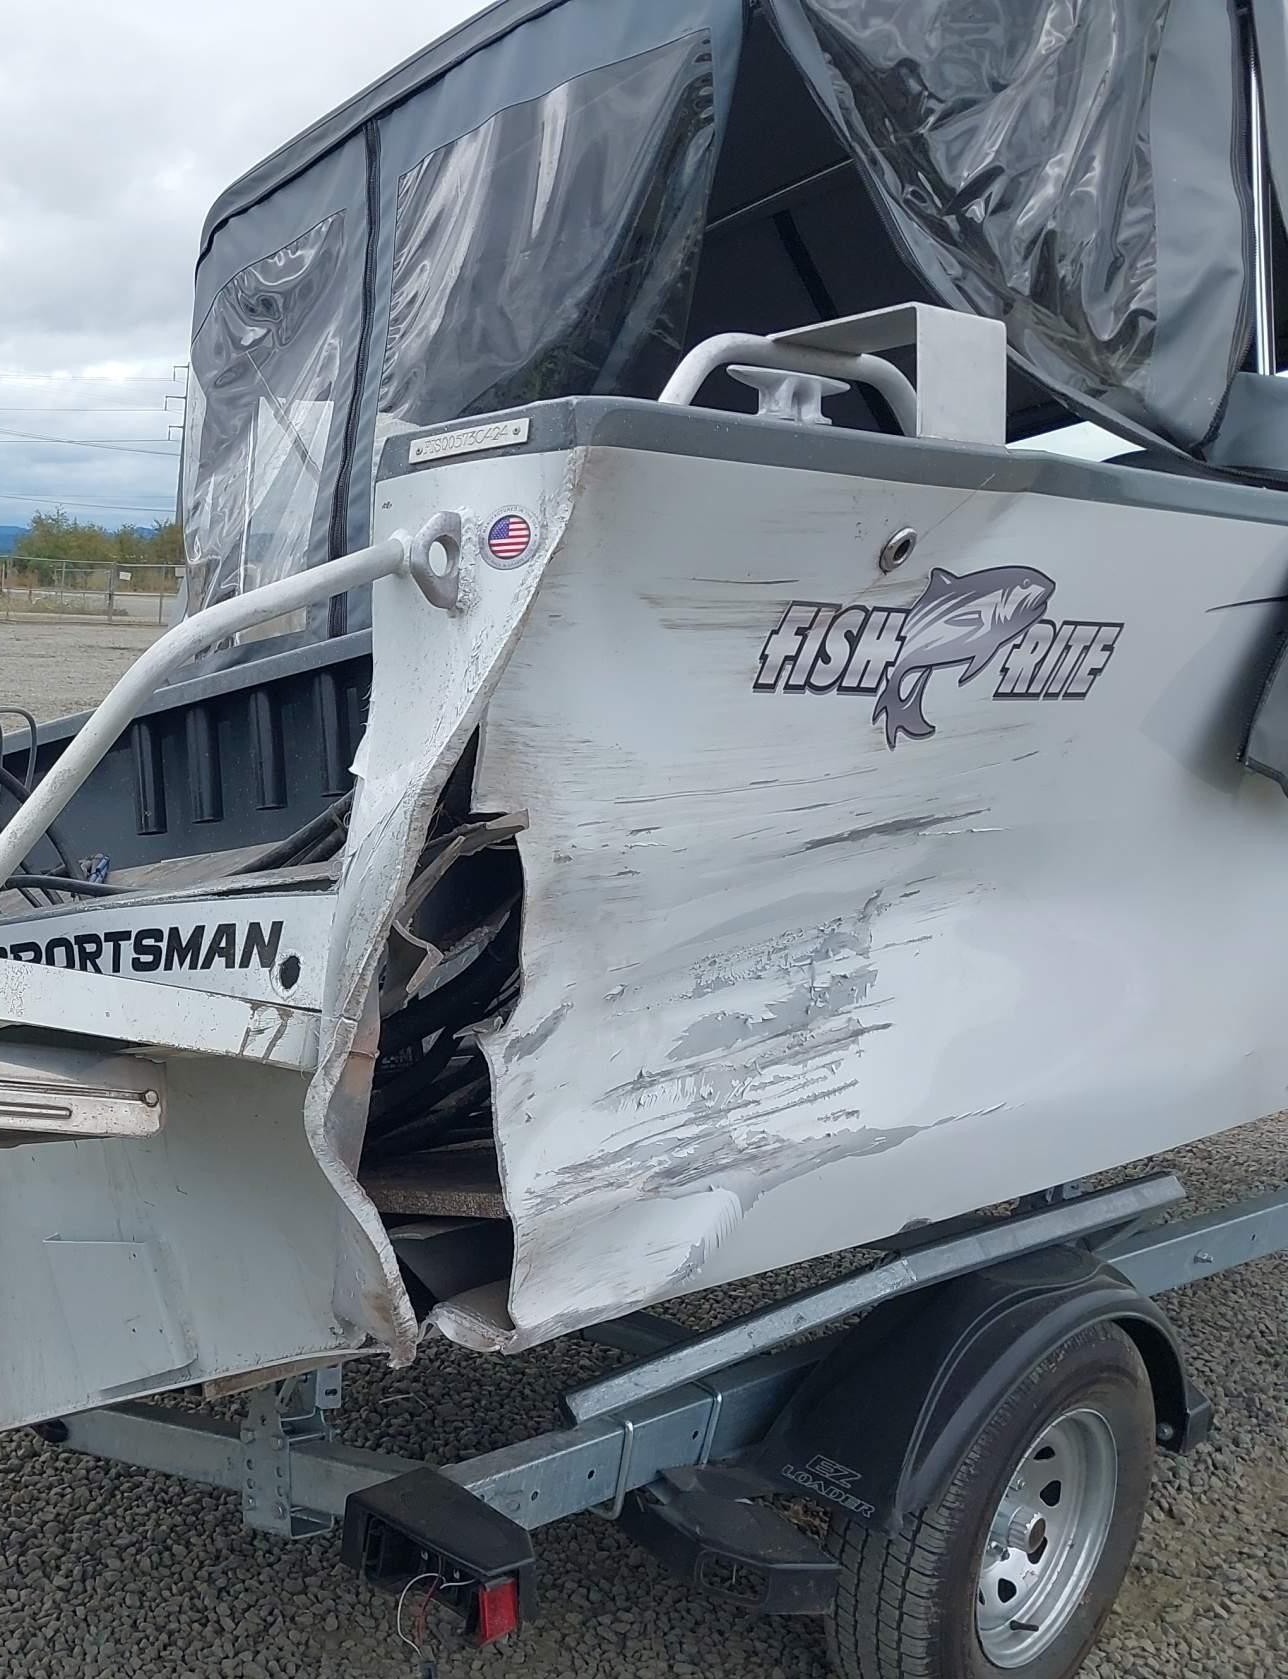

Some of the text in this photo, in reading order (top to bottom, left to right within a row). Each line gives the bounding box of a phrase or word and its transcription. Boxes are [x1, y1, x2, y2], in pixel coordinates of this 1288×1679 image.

[752, 600, 1124, 701] FISH RITE
[782, 1464, 876, 1518] LOADER
[806, 1454, 862, 1489] EZ
